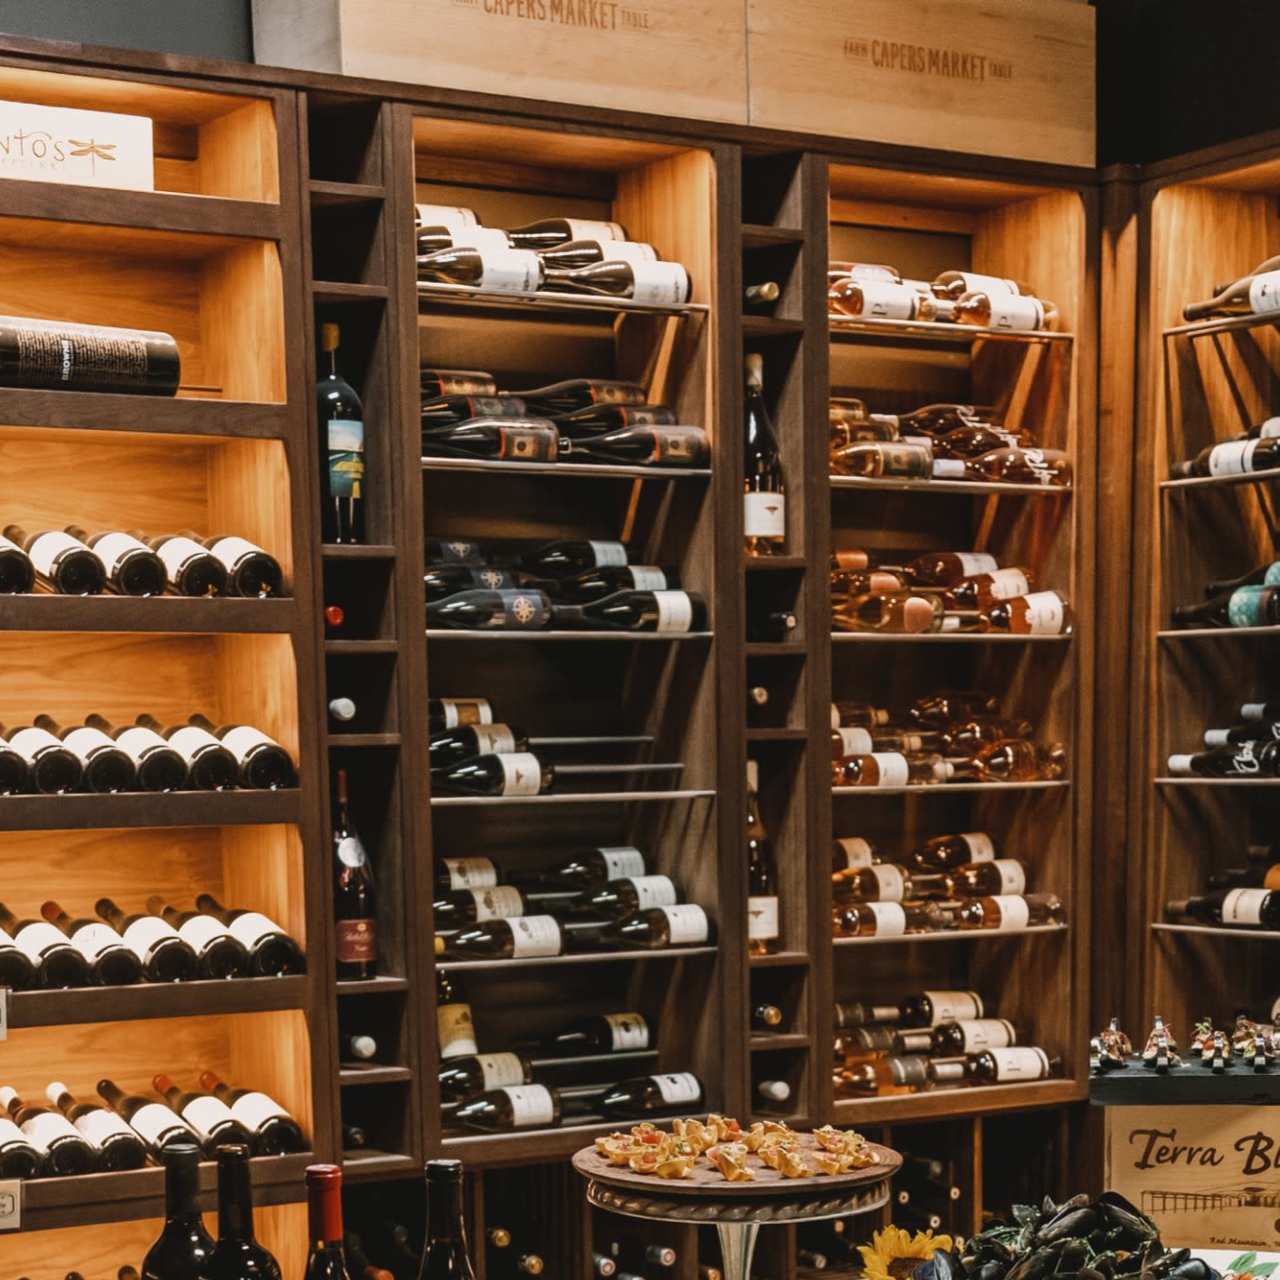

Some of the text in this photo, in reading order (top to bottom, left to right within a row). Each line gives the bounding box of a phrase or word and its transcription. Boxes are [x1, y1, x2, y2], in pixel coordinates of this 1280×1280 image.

[549, 0, 618, 30] MARKET
[871, 39, 925, 72] CAPERS
[927, 48, 987, 81] MARKET
[1129, 1128, 1224, 1170] Terra
